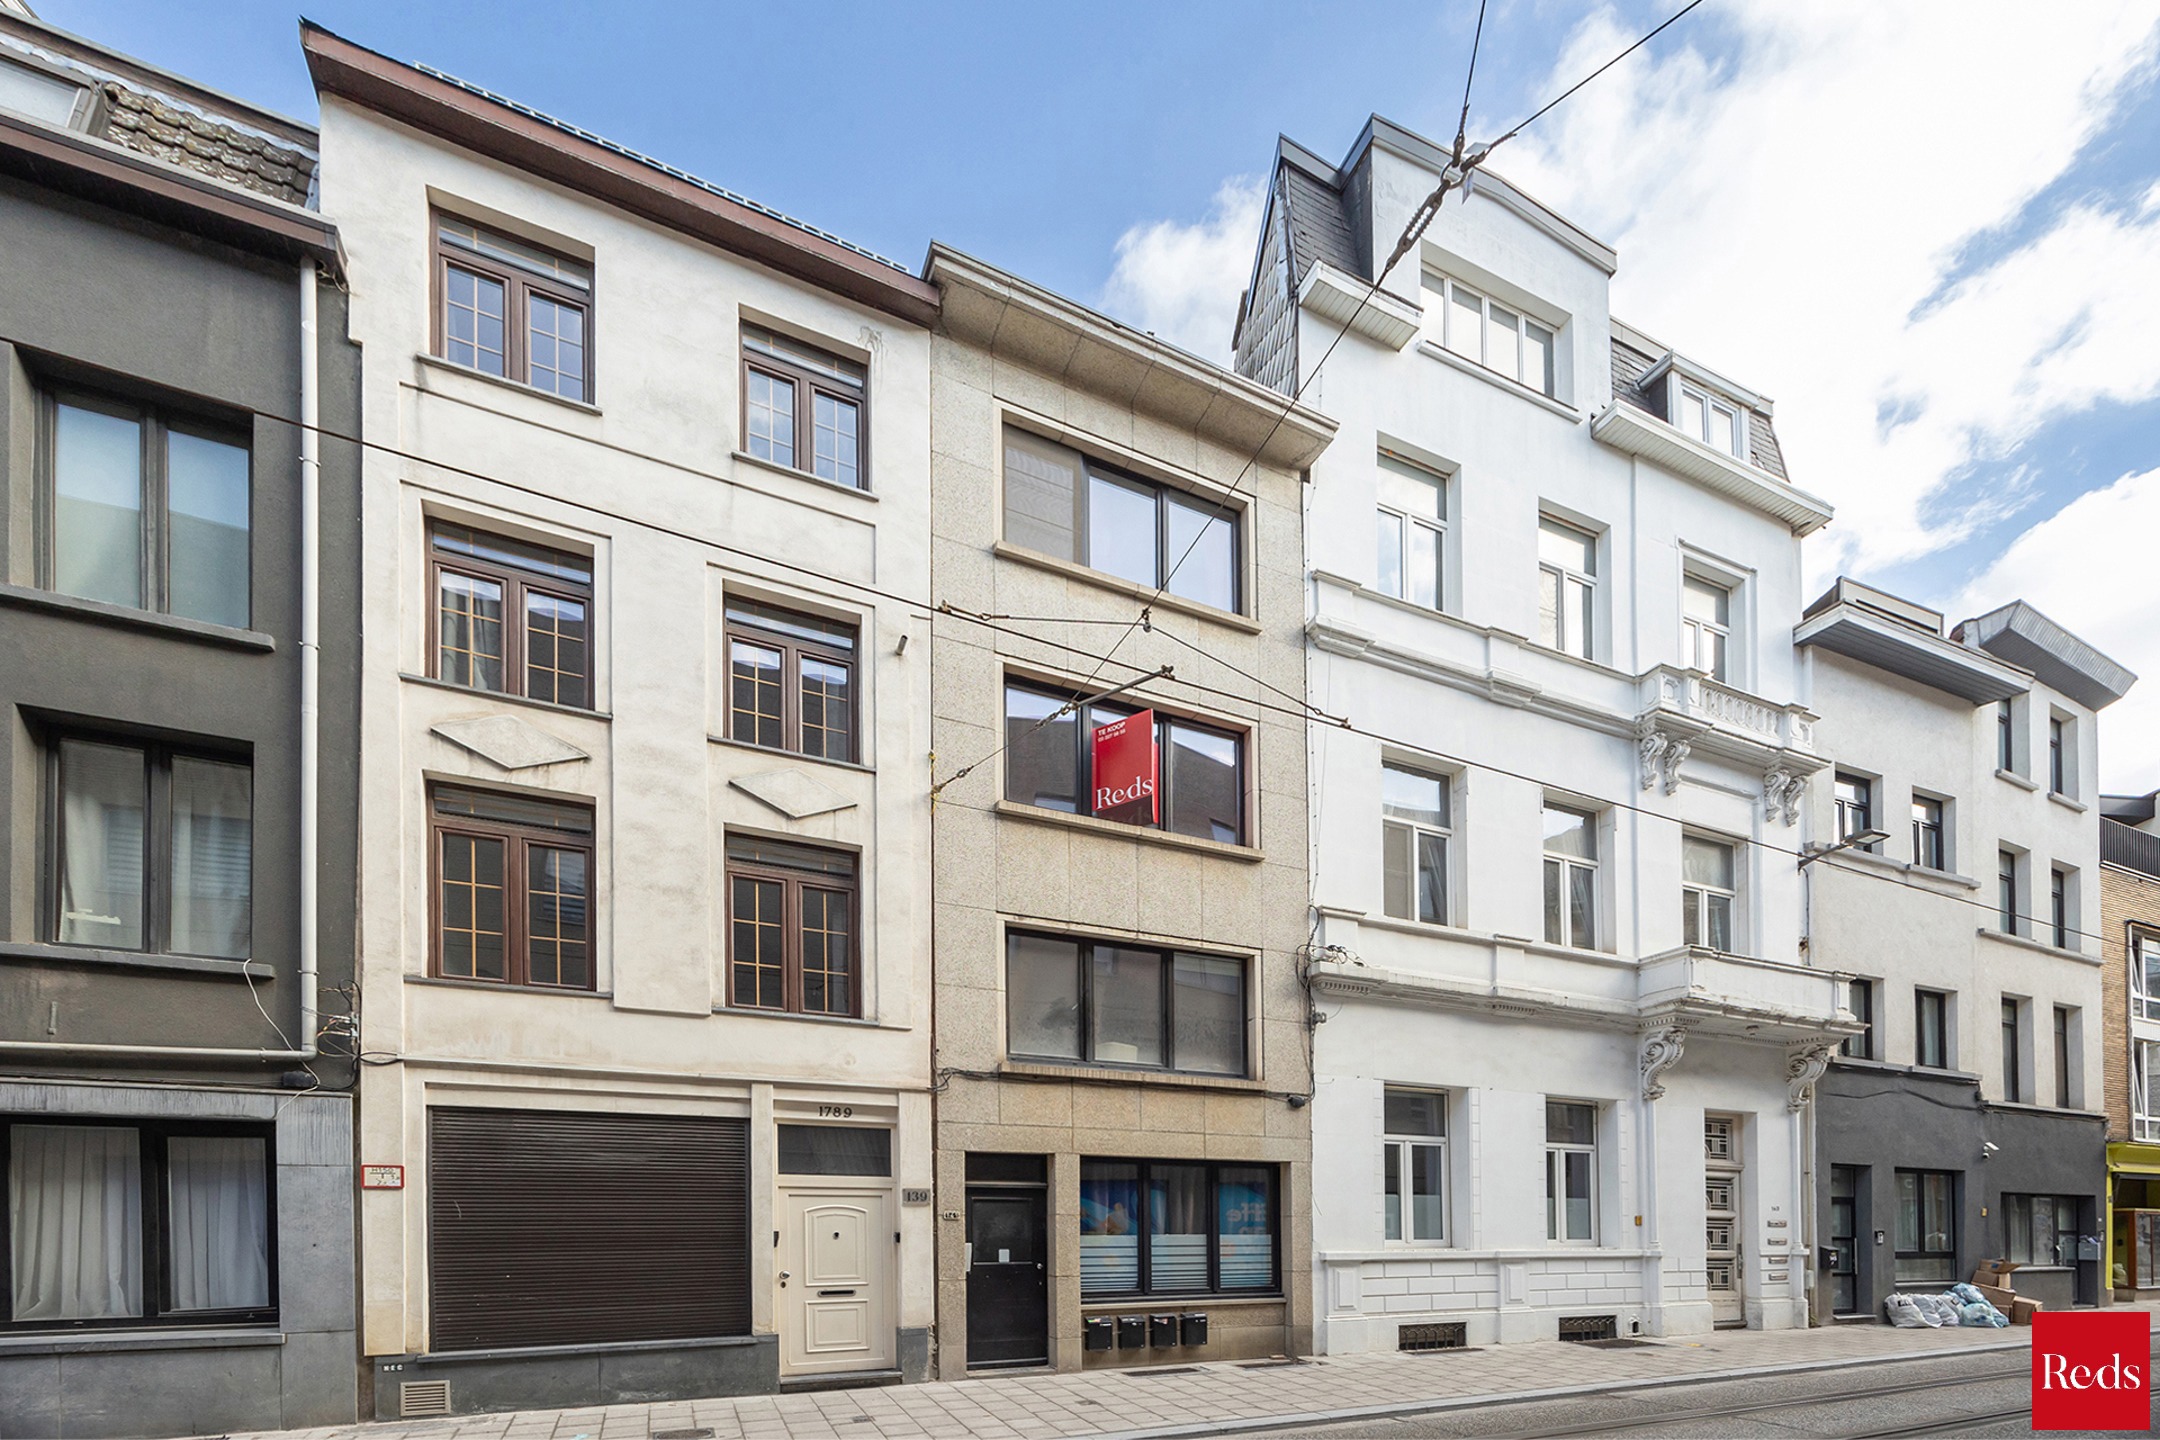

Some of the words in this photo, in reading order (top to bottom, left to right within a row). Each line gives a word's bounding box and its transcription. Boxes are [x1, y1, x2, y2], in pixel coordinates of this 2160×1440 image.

[1097, 728, 1106, 736] TE
[1107, 721, 1126, 733] KOOP
[1096, 776, 1152, 809] Reds
[818, 1106, 852, 1118] 1789
[907, 1191, 928, 1202] 139
